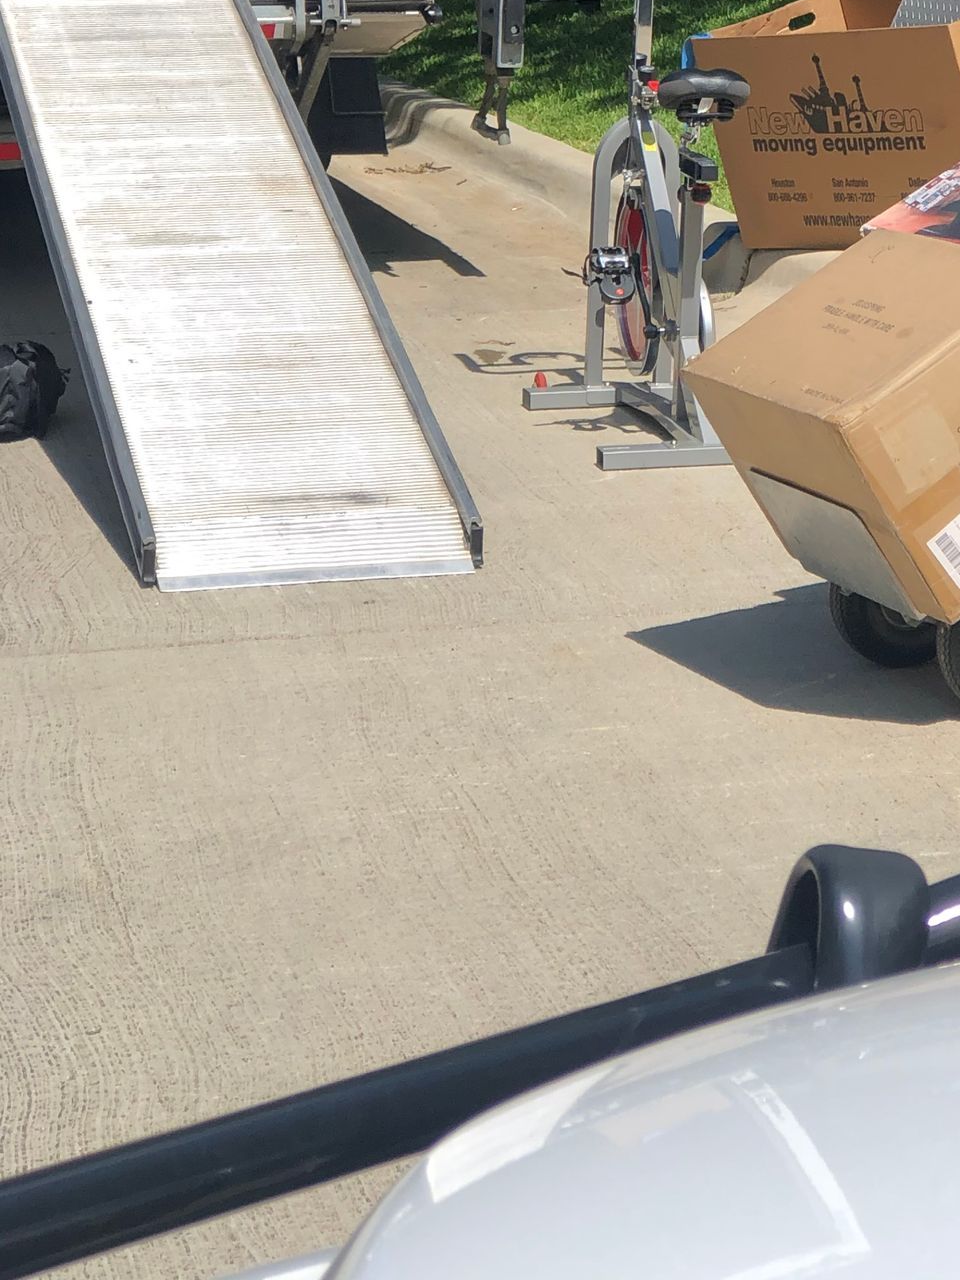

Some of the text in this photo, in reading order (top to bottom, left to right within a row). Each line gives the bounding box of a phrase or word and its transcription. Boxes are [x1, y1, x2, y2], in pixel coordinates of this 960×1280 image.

[747, 105, 925, 135] New Haven
[752, 135, 926, 156] moving equipment
[771, 178, 795, 188] Houston
[831, 177, 869, 187] San Antonio
[803, 212, 874, 227] www.newhave
